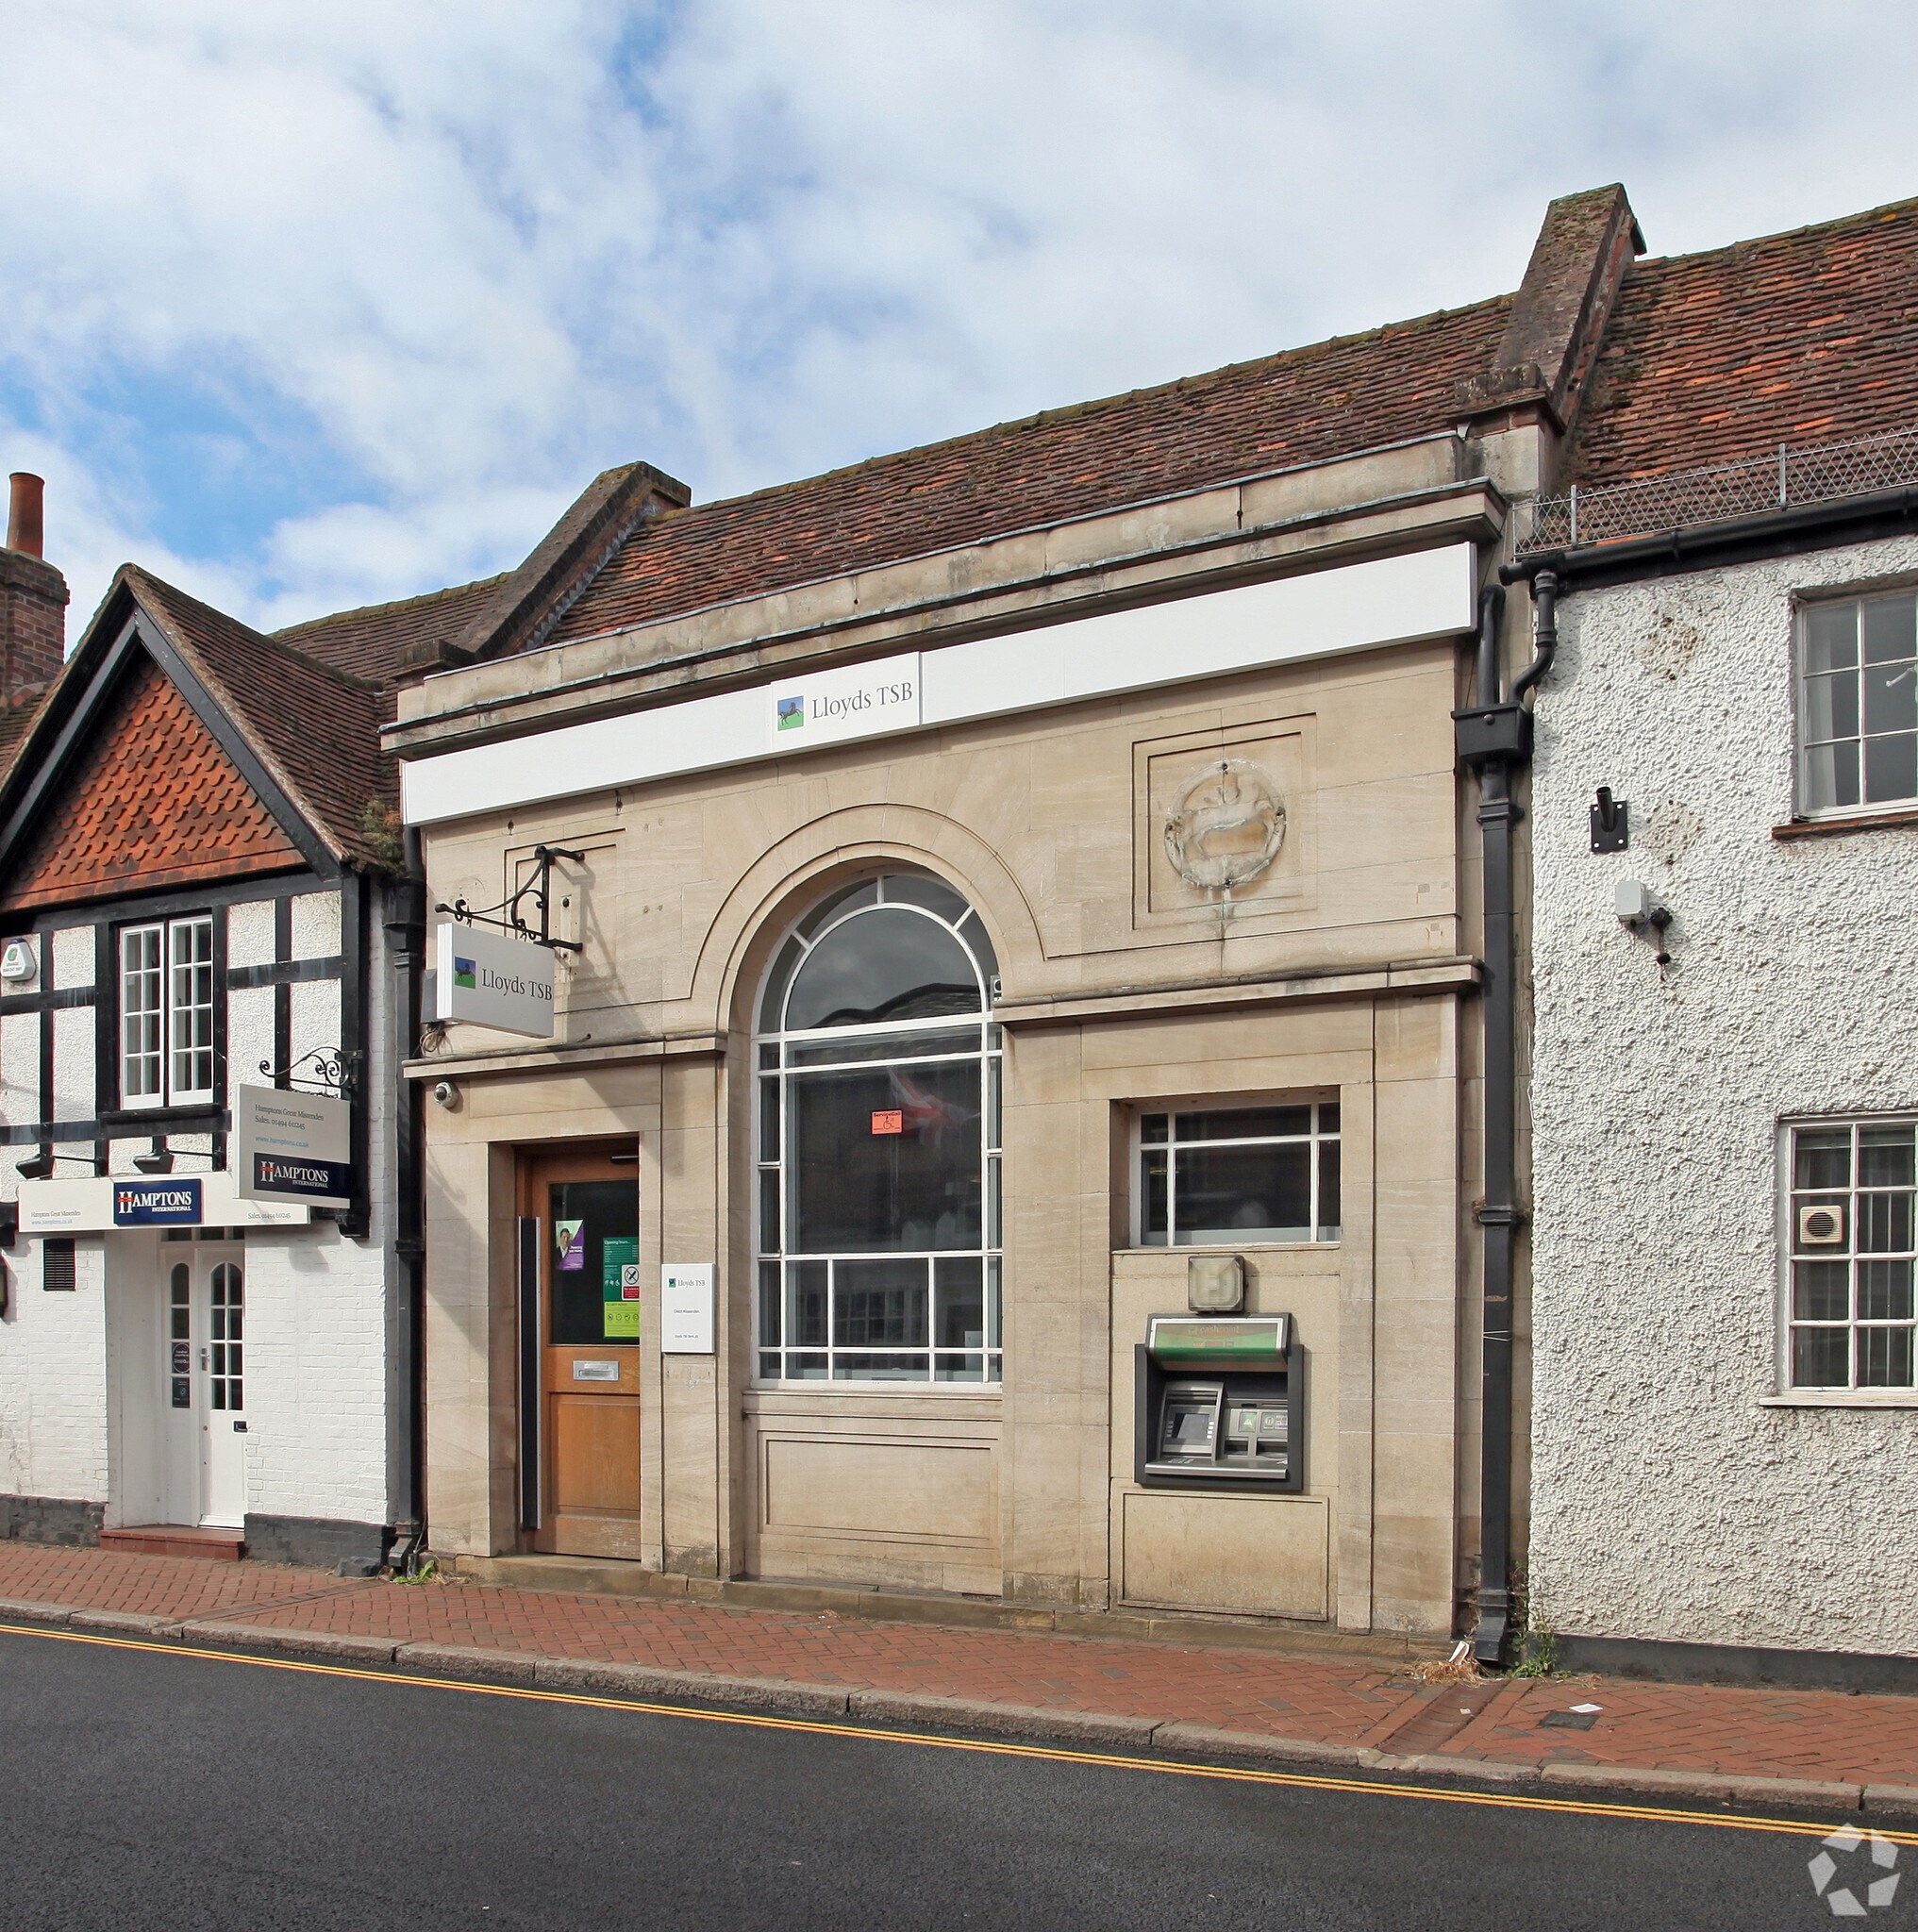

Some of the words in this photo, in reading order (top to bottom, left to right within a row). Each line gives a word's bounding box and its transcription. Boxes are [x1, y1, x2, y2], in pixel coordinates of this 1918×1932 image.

[811, 690, 872, 720] Lloyds
[876, 682, 913, 706] TSB
[482, 969, 525, 996] Lloyds
[528, 981, 552, 1000] TSB
[255, 1105, 282, 1114] Hamptons
[283, 1108, 297, 1117] Great
[298, 1111, 325, 1121] Missenden
[259, 1161, 329, 1183] HAMPTONS
[118, 1191, 192, 1214] HAMPTONS
[677, 1279, 694, 1288] Lloyds
